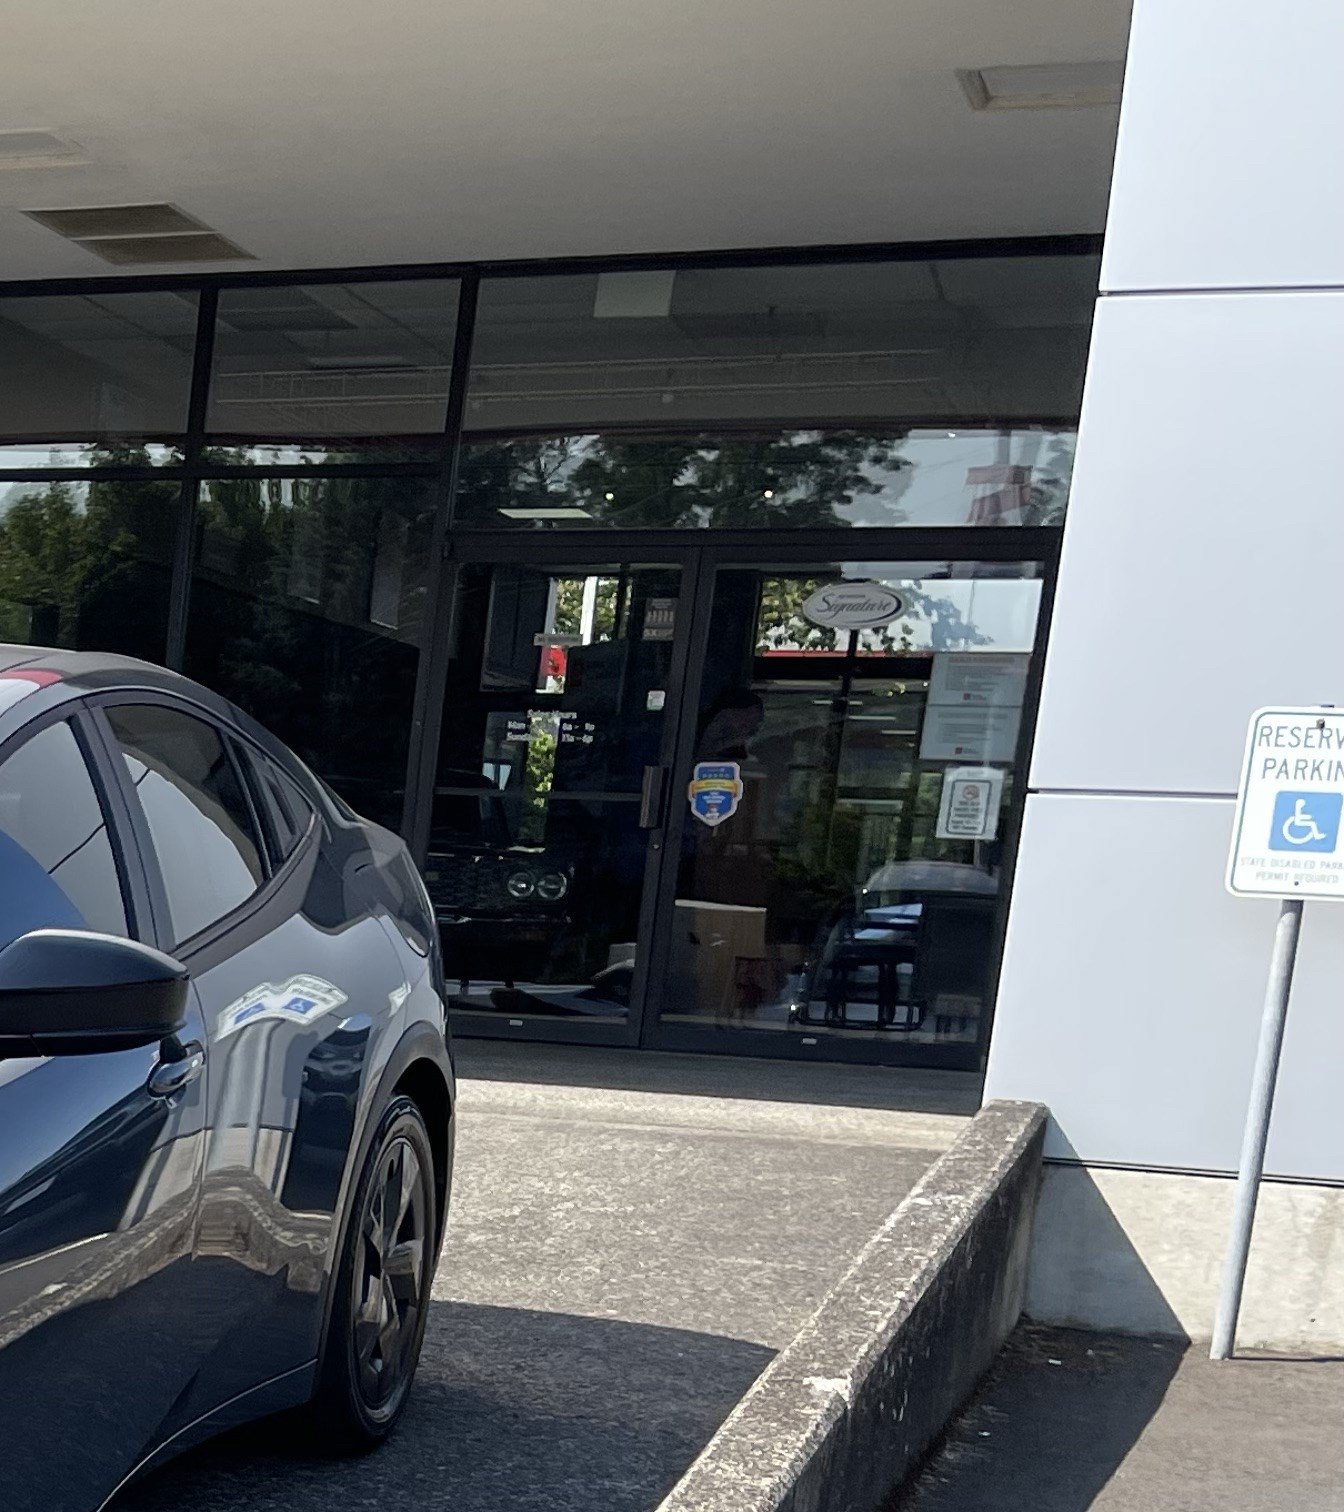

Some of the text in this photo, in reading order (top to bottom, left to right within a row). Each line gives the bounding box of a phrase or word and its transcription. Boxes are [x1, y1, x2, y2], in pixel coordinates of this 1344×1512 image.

[816, 594, 892, 619] Signature
[1270, 857, 1316, 870] DISABLED
[1255, 870, 1340, 884] PERMIT REQUIRED
